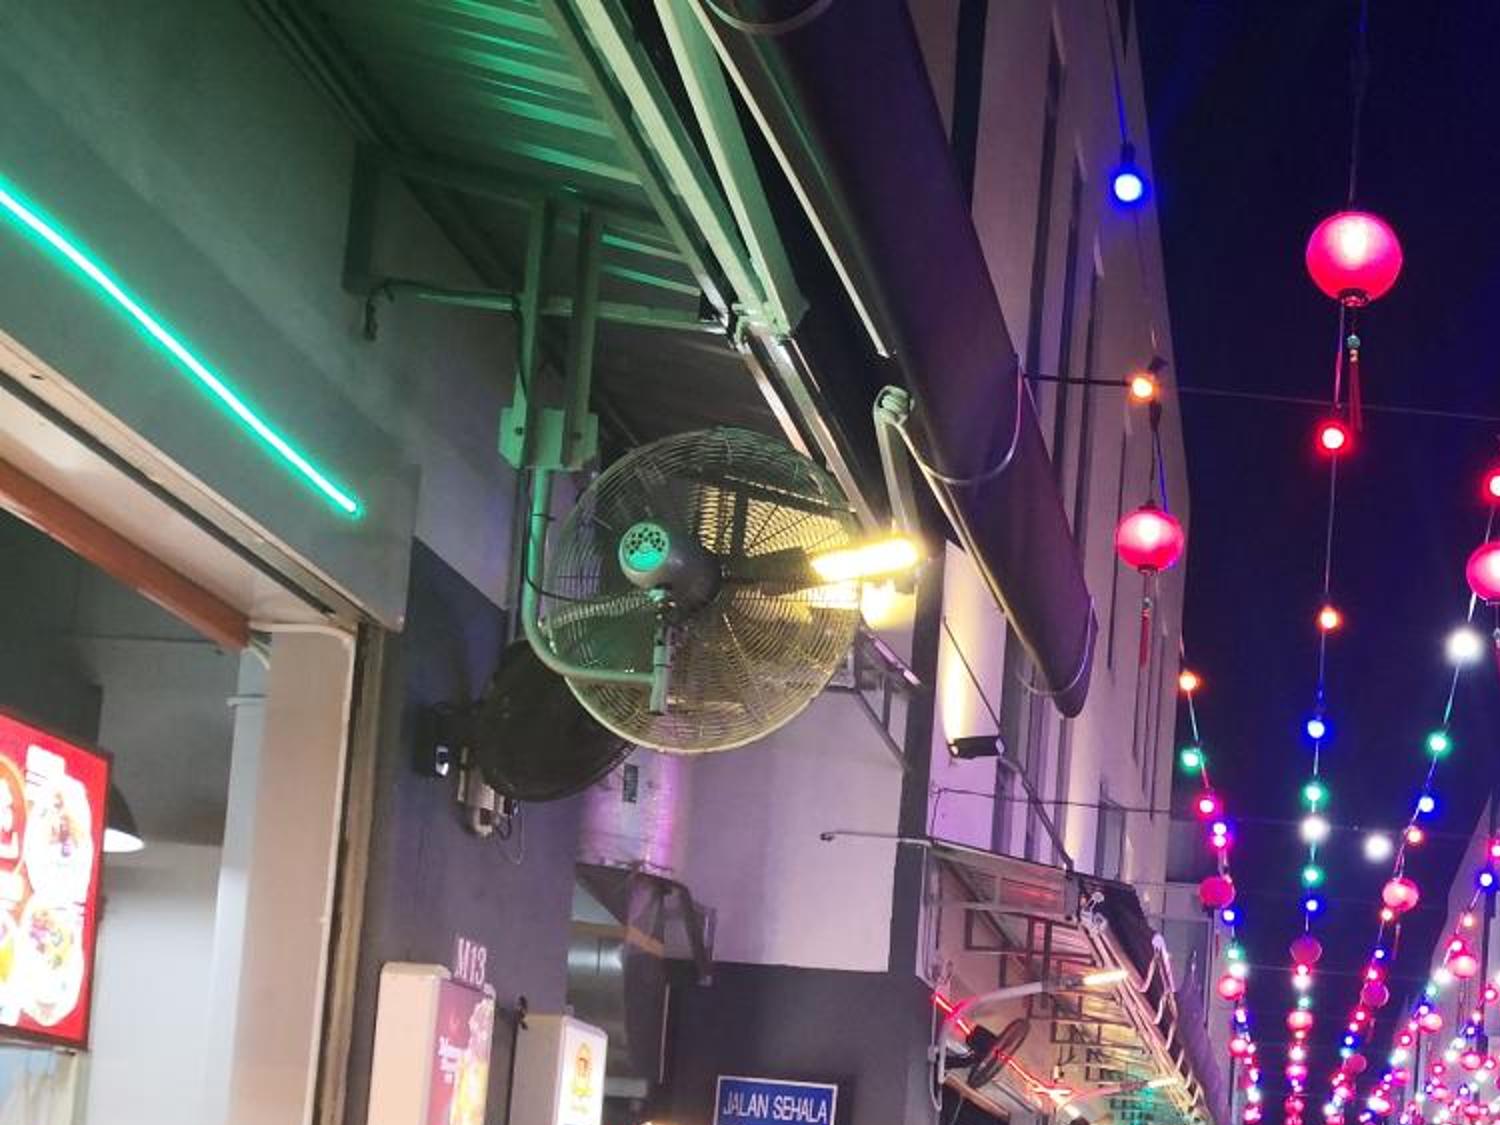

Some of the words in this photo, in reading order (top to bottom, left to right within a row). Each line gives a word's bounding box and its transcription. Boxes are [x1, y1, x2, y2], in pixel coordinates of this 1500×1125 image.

[453, 937, 488, 985] M13
[723, 1090, 769, 1119] JALAN
[772, 1094, 828, 1125] SEHALA
